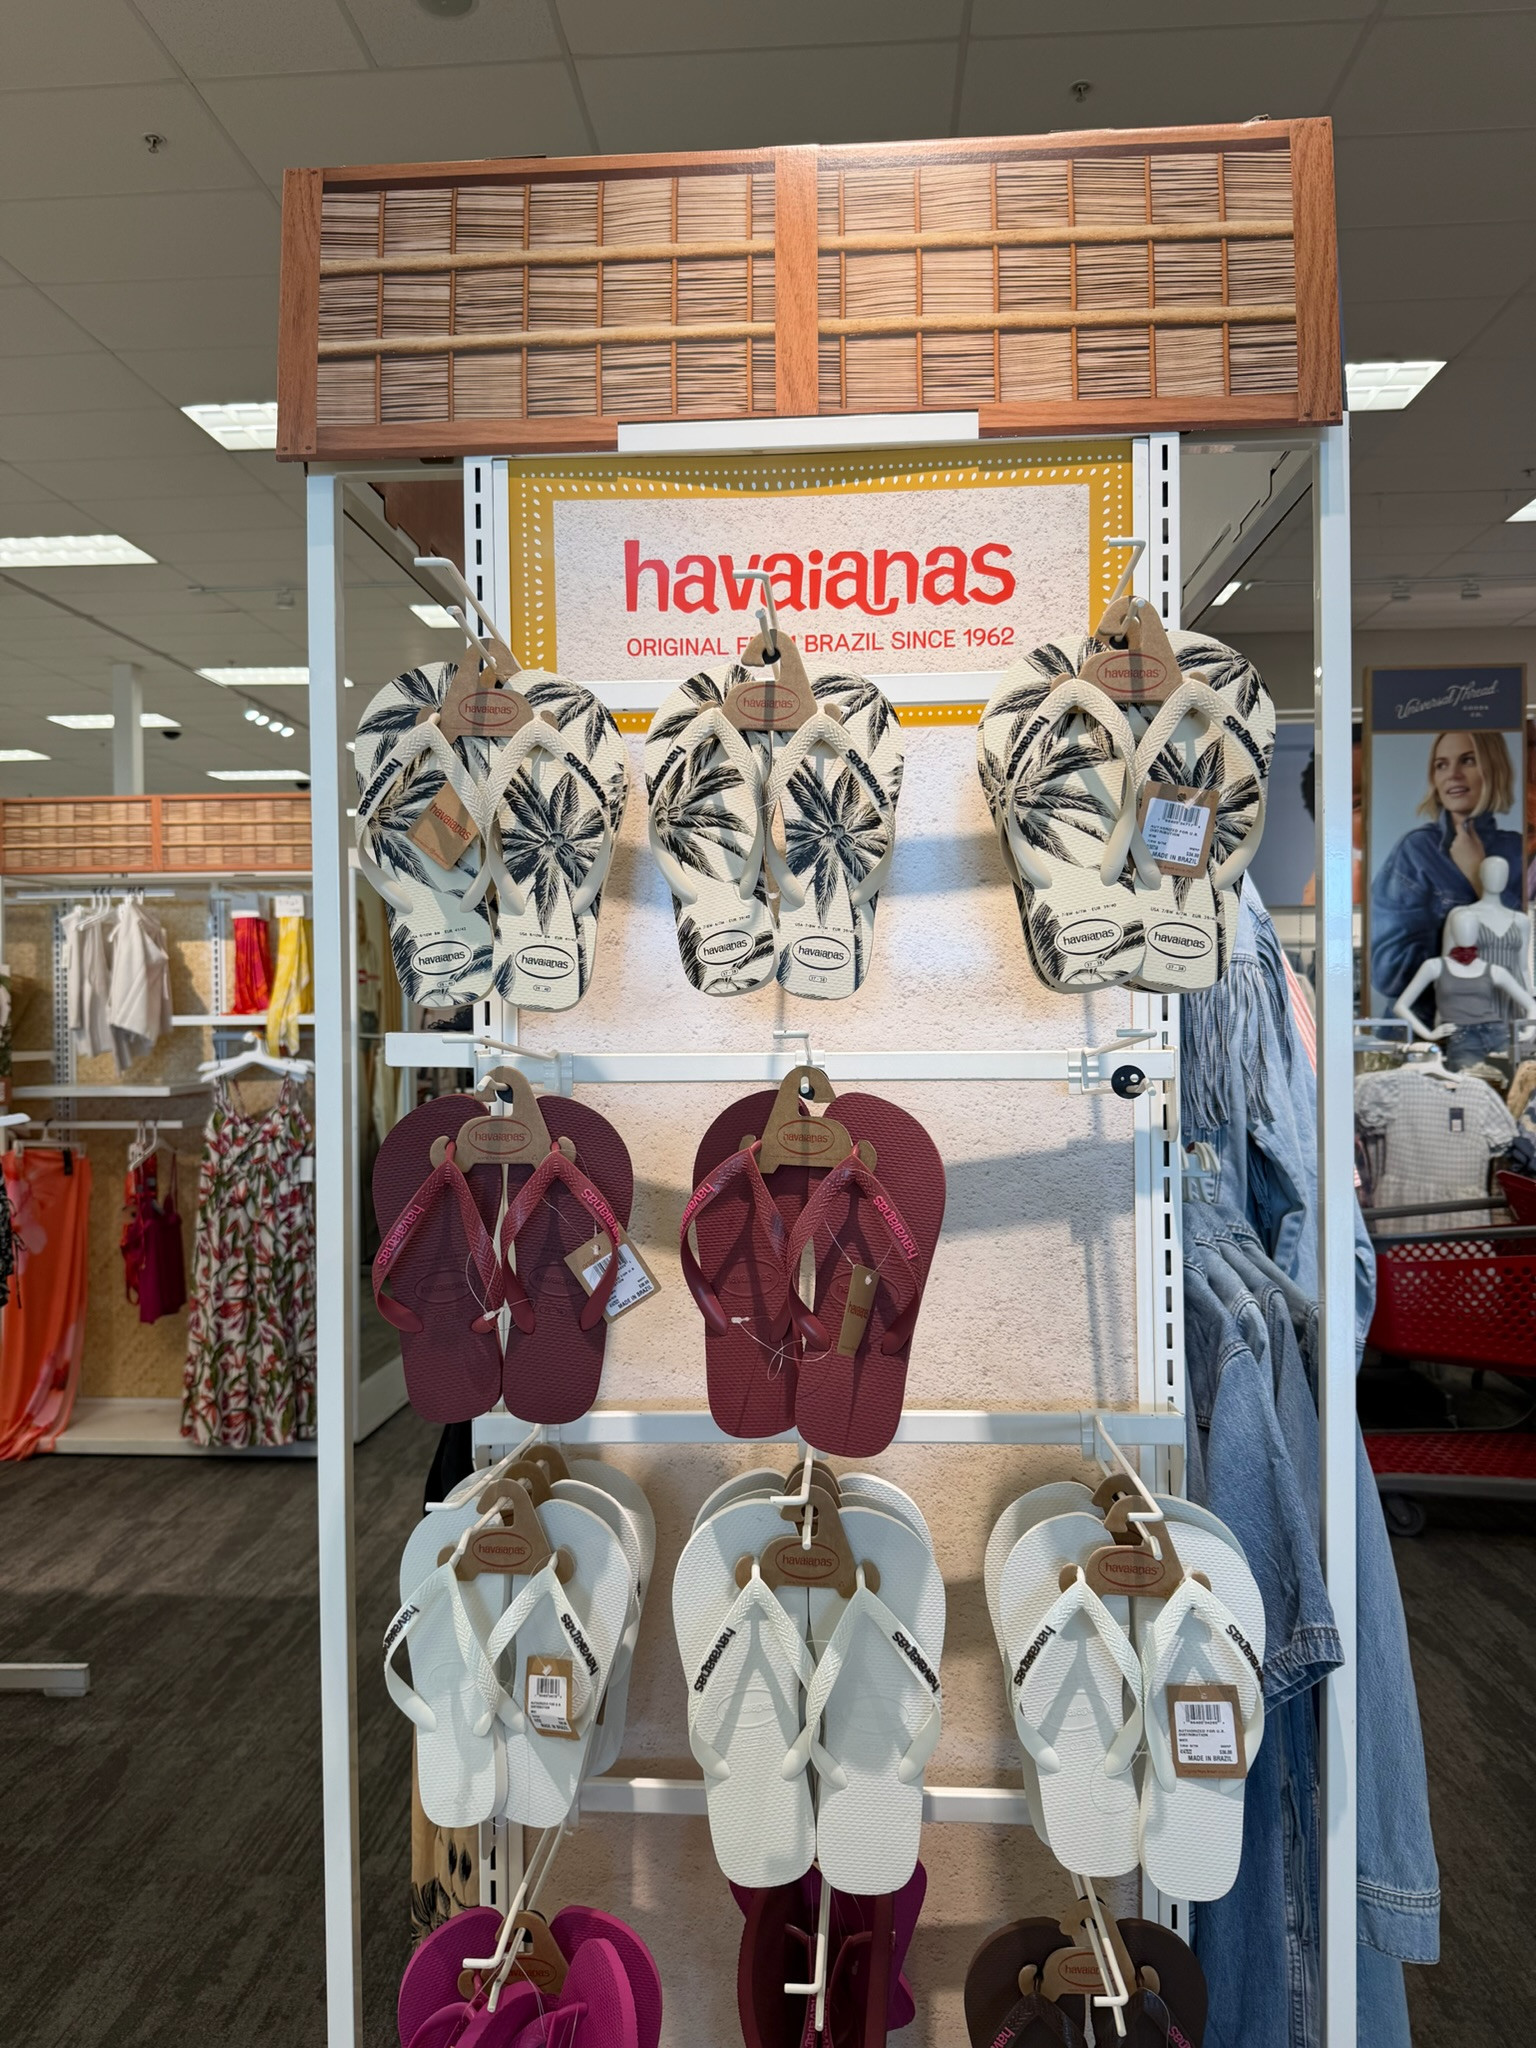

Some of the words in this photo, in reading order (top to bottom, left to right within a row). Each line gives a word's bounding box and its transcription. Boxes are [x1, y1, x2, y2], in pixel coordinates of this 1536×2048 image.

[624, 540, 1016, 616] havaianas
[627, 637, 729, 657] ORIGINAL
[805, 633, 884, 652] BRAZIL
[891, 629, 956, 649] SINCE
[963, 626, 1015, 647] 1962
[1104, 668, 1159, 679] havaianas
[743, 697, 793, 708] havaianas
[1446, 680, 1499, 707] Thread
[465, 703, 512, 715] havaianas
[358, 757, 403, 816] havaianas
[846, 749, 889, 808] havaianas
[430, 802, 472, 841] havaianas
[1152, 851, 1169, 860] MADE
[1178, 855, 1198, 865] BRAZIL
[1062, 929, 1115, 946] havaianas
[1154, 931, 1205, 949] havaianas
[703, 939, 748, 957] havaianas
[798, 945, 845, 960] havaianas
[418, 951, 466, 966] havaianas
[522, 955, 568, 970] havaianas
[475, 1131, 525, 1142] havaianas
[377, 1204, 425, 1266] havaianas
[873, 1195, 918, 1260] havaianas
[479, 1543, 525, 1555] havaianas
[782, 1554, 833, 1567] havaianas
[1105, 1562, 1158, 1576] havaianas
[561, 1613, 599, 1676] havaianas
[694, 1626, 736, 1692] havaianas
[892, 1631, 940, 1693] havaianas
[1013, 1624, 1056, 1686] havaianas
